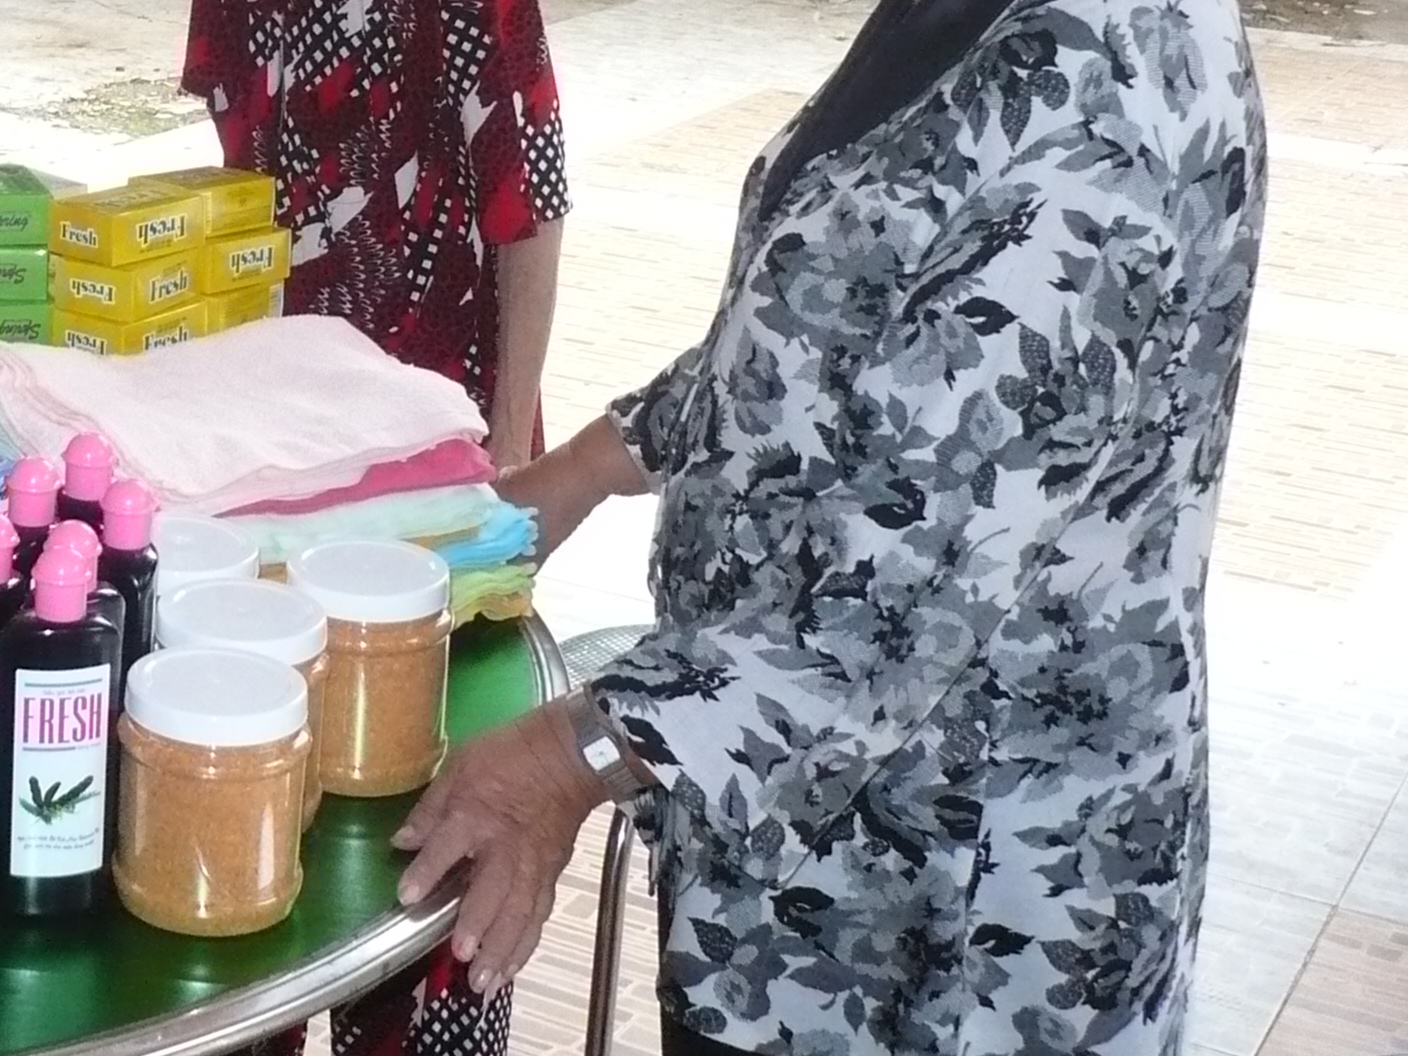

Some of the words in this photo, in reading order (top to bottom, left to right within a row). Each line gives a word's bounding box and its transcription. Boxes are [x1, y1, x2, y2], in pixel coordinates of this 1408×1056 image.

[61, 223, 98, 247] Fresh
[137, 215, 186, 246] Fresh
[231, 246, 274, 274] Fresh
[71, 279, 114, 303] Fresh
[150, 270, 189, 303] Fresh
[23, 692, 102, 744] FRESH
